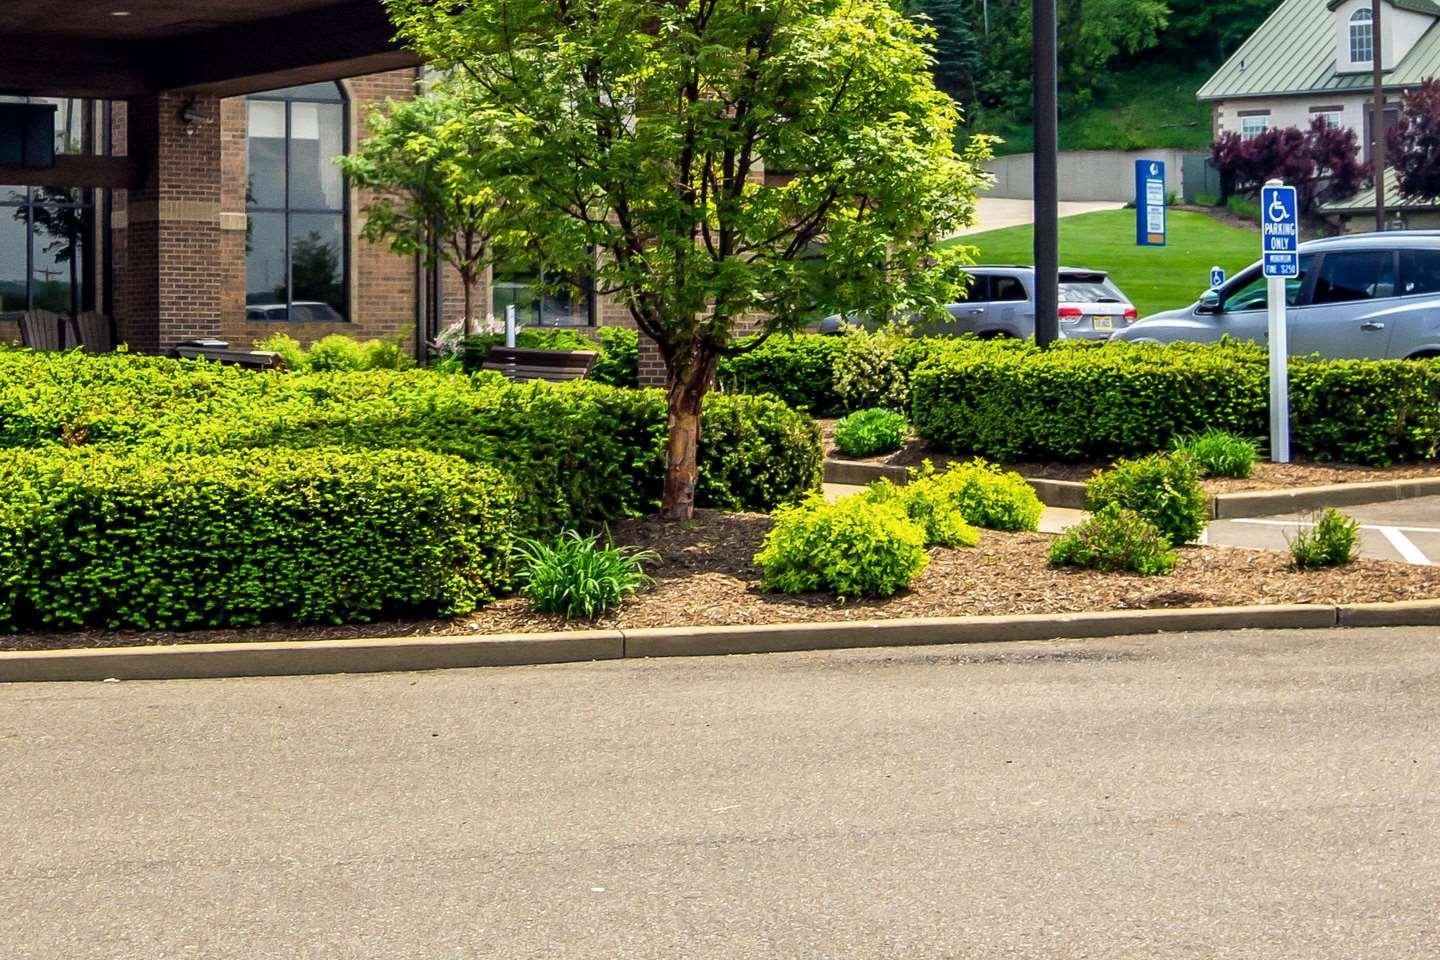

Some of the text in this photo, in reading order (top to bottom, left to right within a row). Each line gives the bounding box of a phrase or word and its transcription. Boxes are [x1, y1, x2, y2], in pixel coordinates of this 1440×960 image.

[1265, 223, 1295, 236] PARKING
[1271, 237, 1289, 250] ONLY
[1266, 264, 1277, 274] FINE
